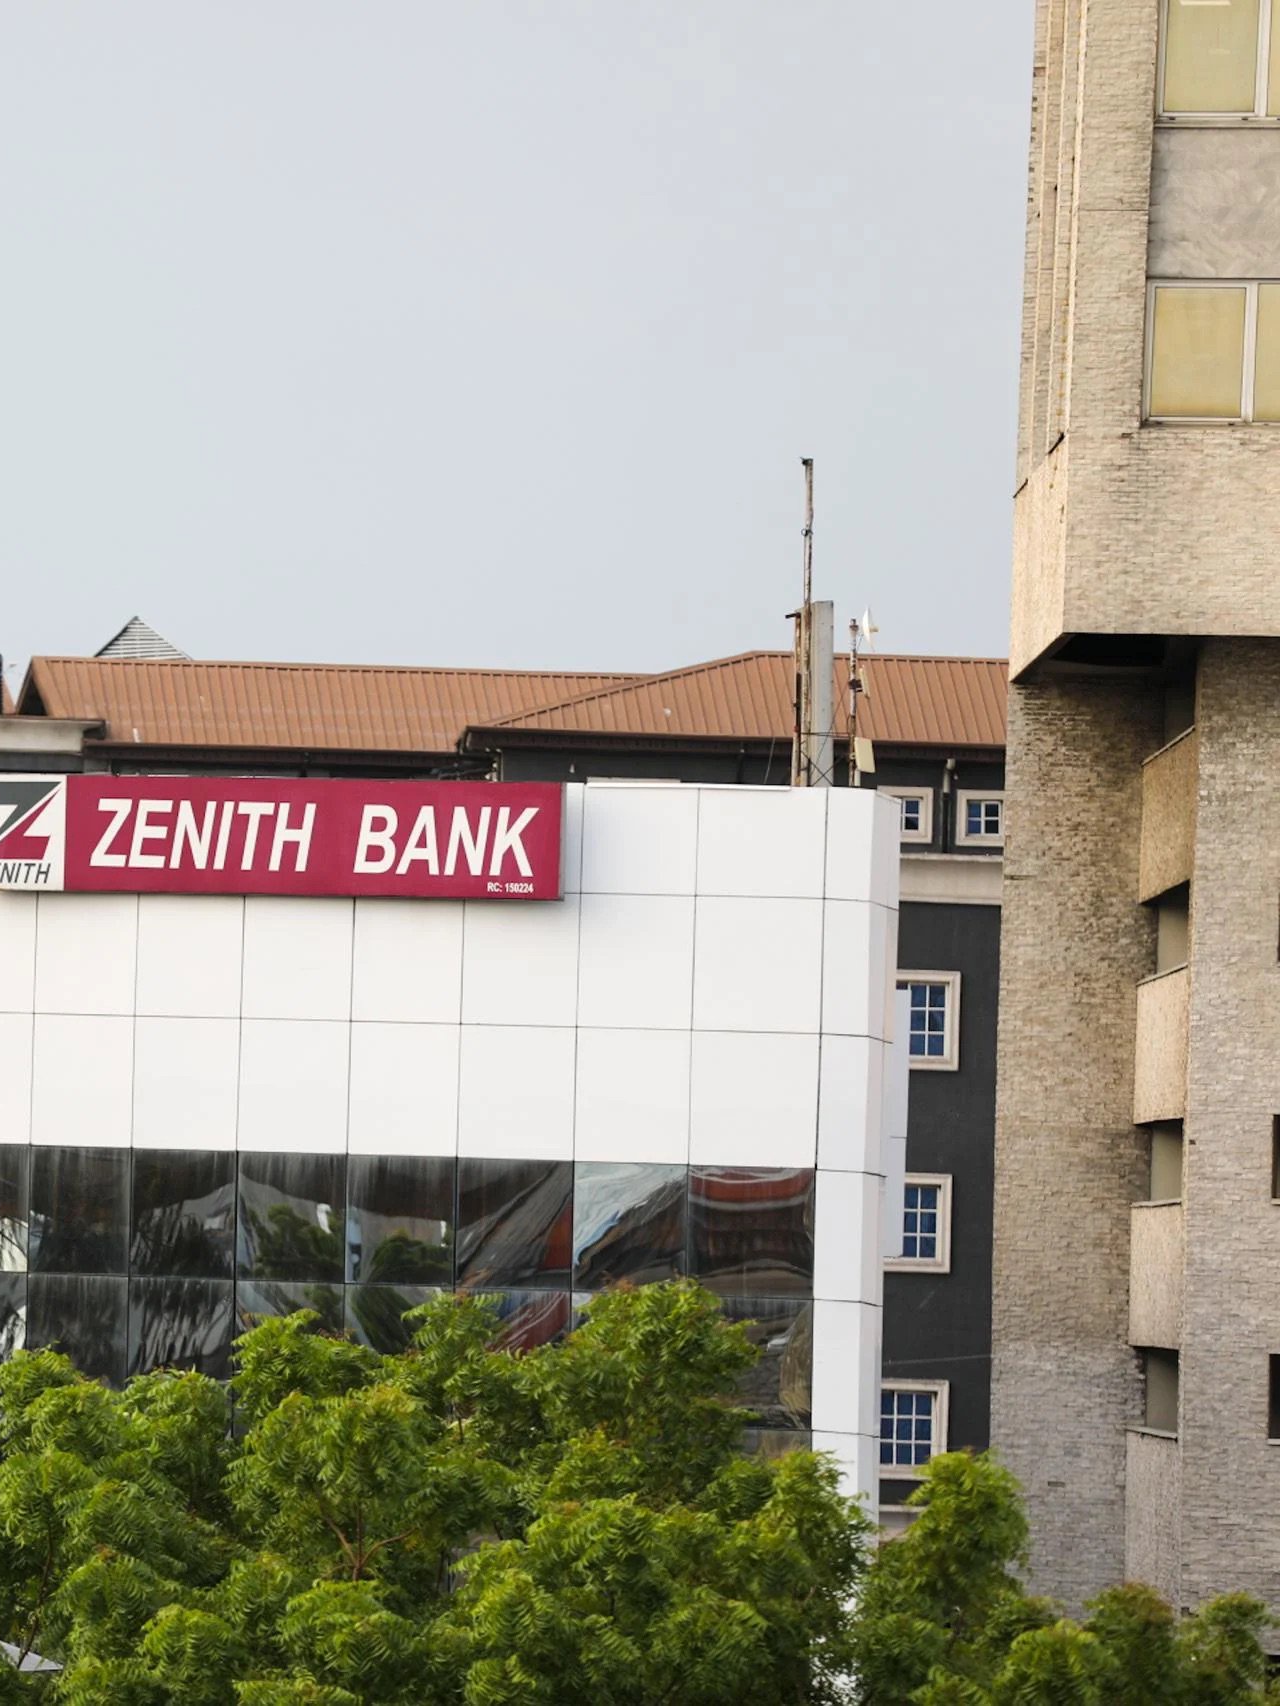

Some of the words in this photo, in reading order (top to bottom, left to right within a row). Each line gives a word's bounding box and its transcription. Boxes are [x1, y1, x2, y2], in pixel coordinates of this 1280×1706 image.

[89, 798, 316, 873] ZENITH
[353, 805, 540, 877] BANK
[487, 882, 503, 892] RC:
[505, 882, 534, 893] 150224
